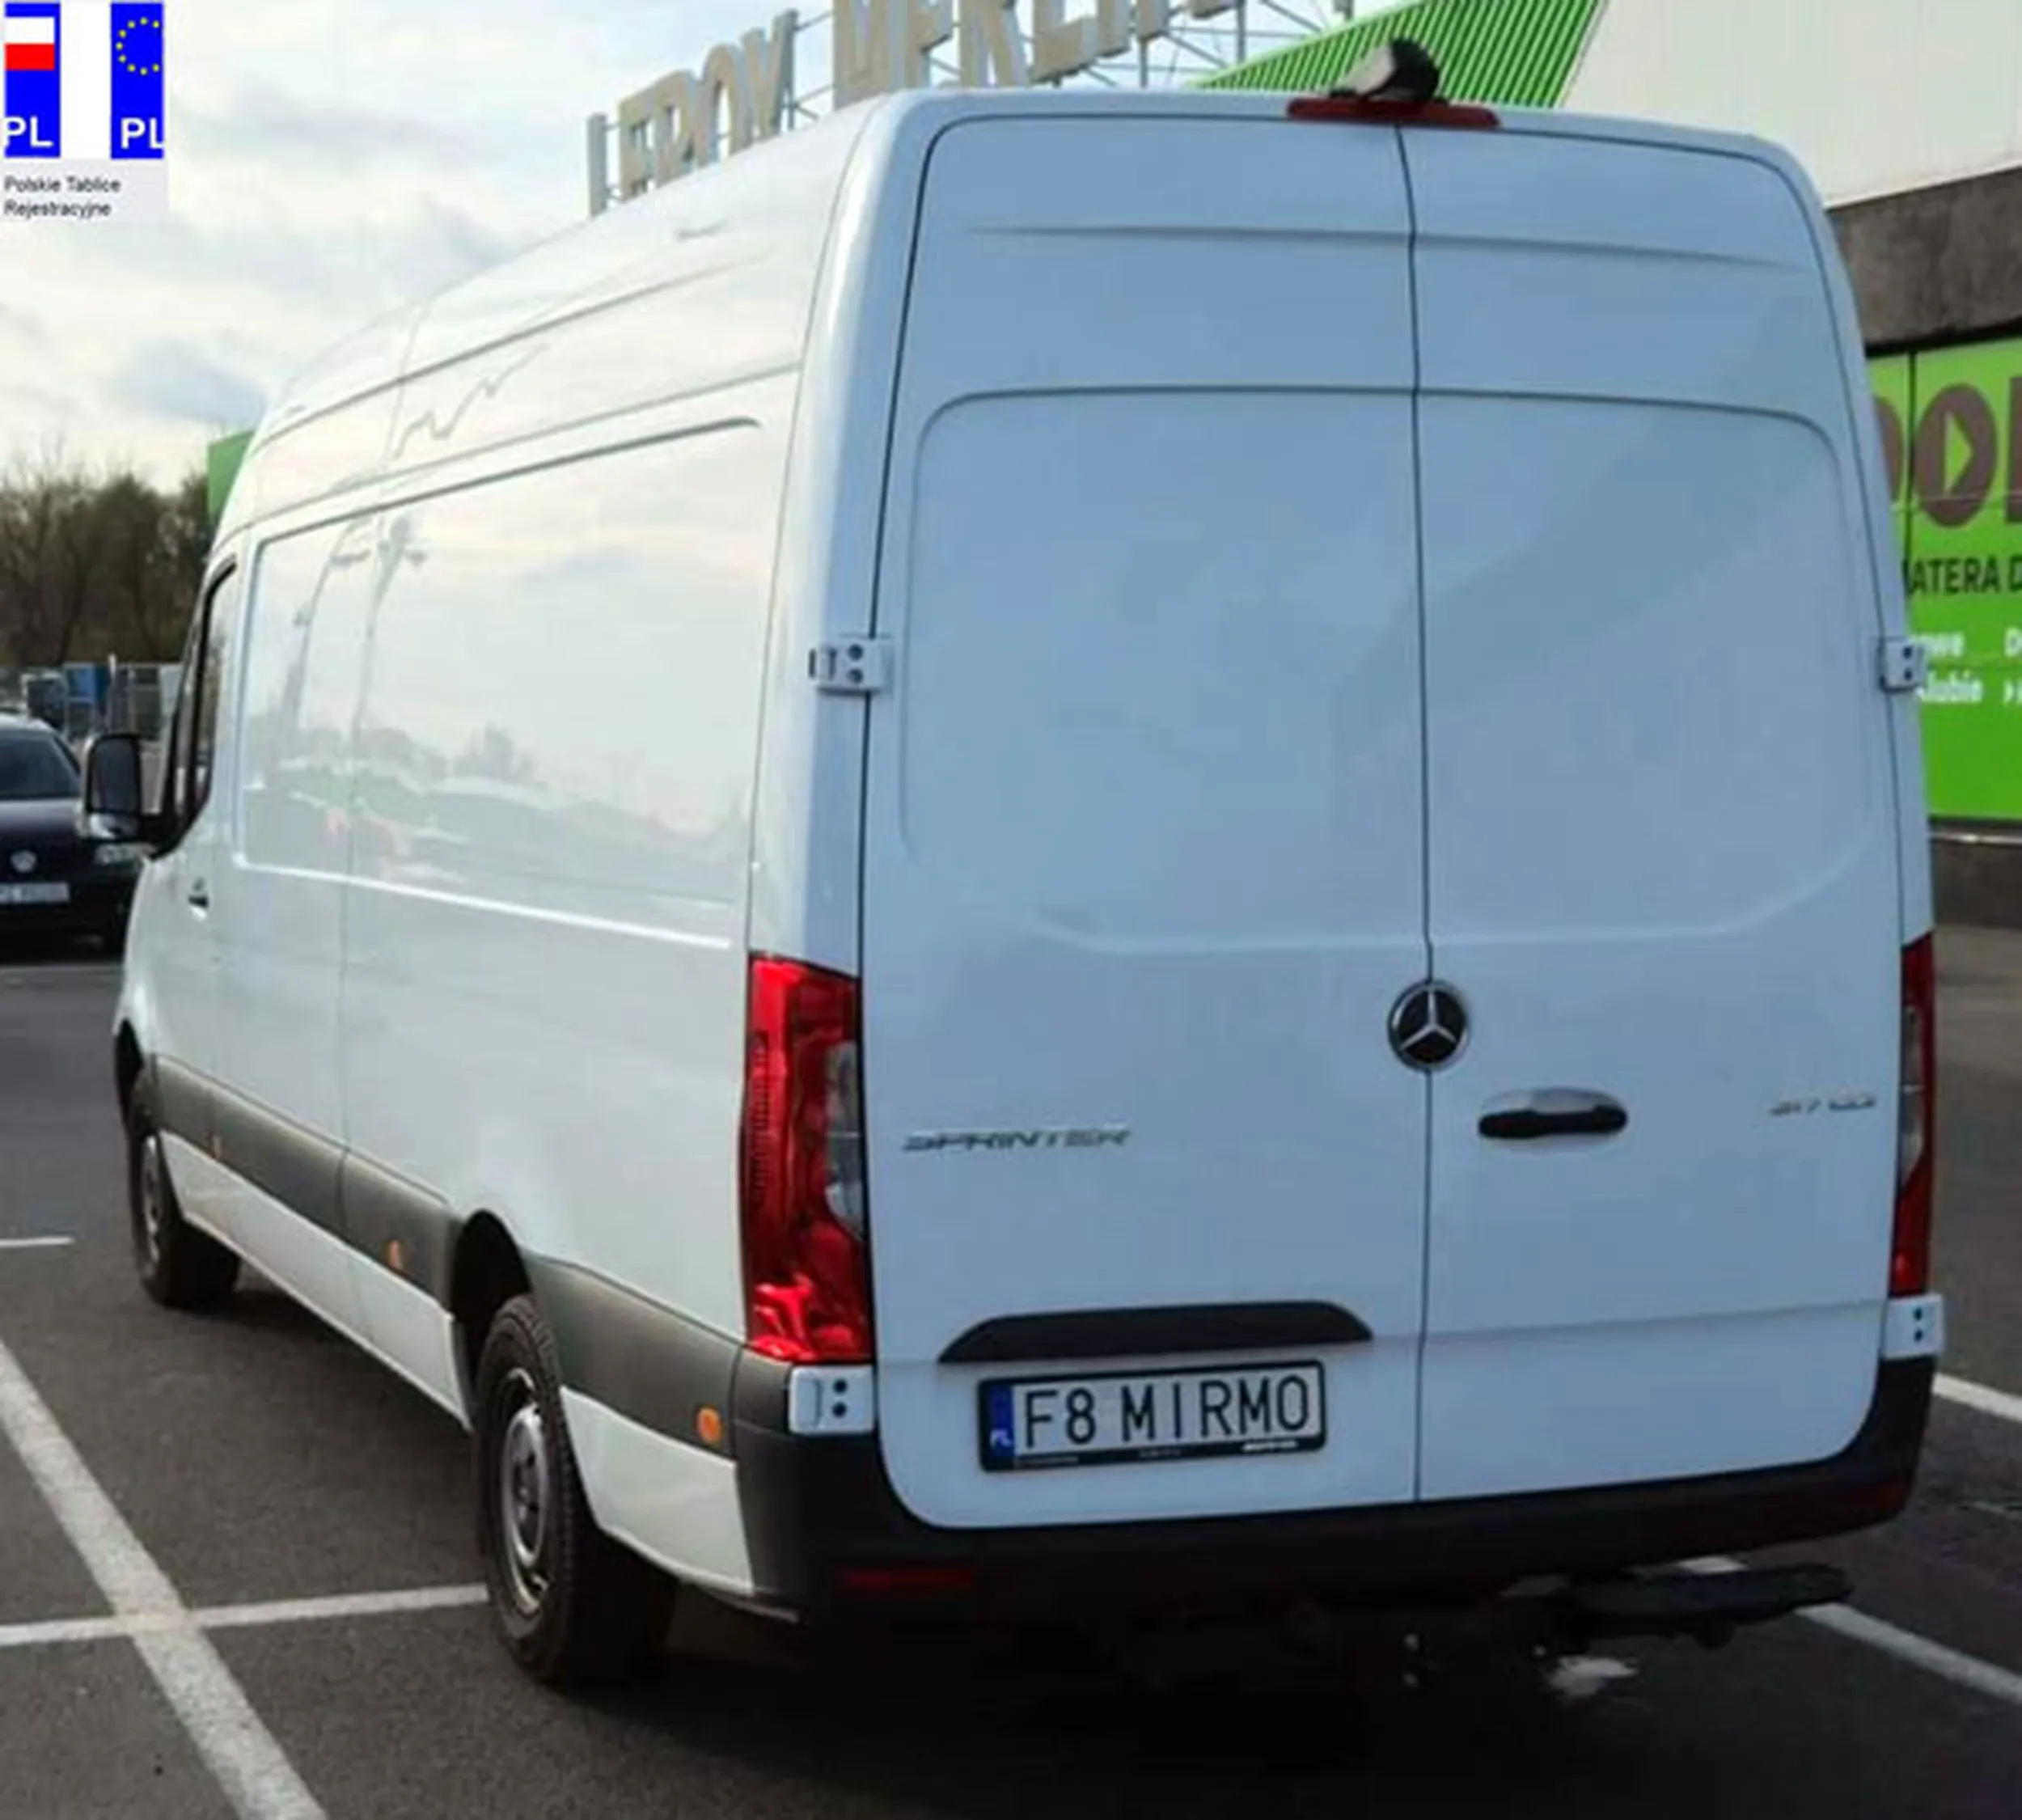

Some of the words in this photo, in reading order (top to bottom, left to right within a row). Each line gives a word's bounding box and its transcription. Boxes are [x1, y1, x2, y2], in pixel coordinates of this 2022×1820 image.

[1902, 554, 2000, 596] ATERA
[1025, 1387, 1096, 1449] F8
[1121, 1375, 1309, 1442] MIRMO
